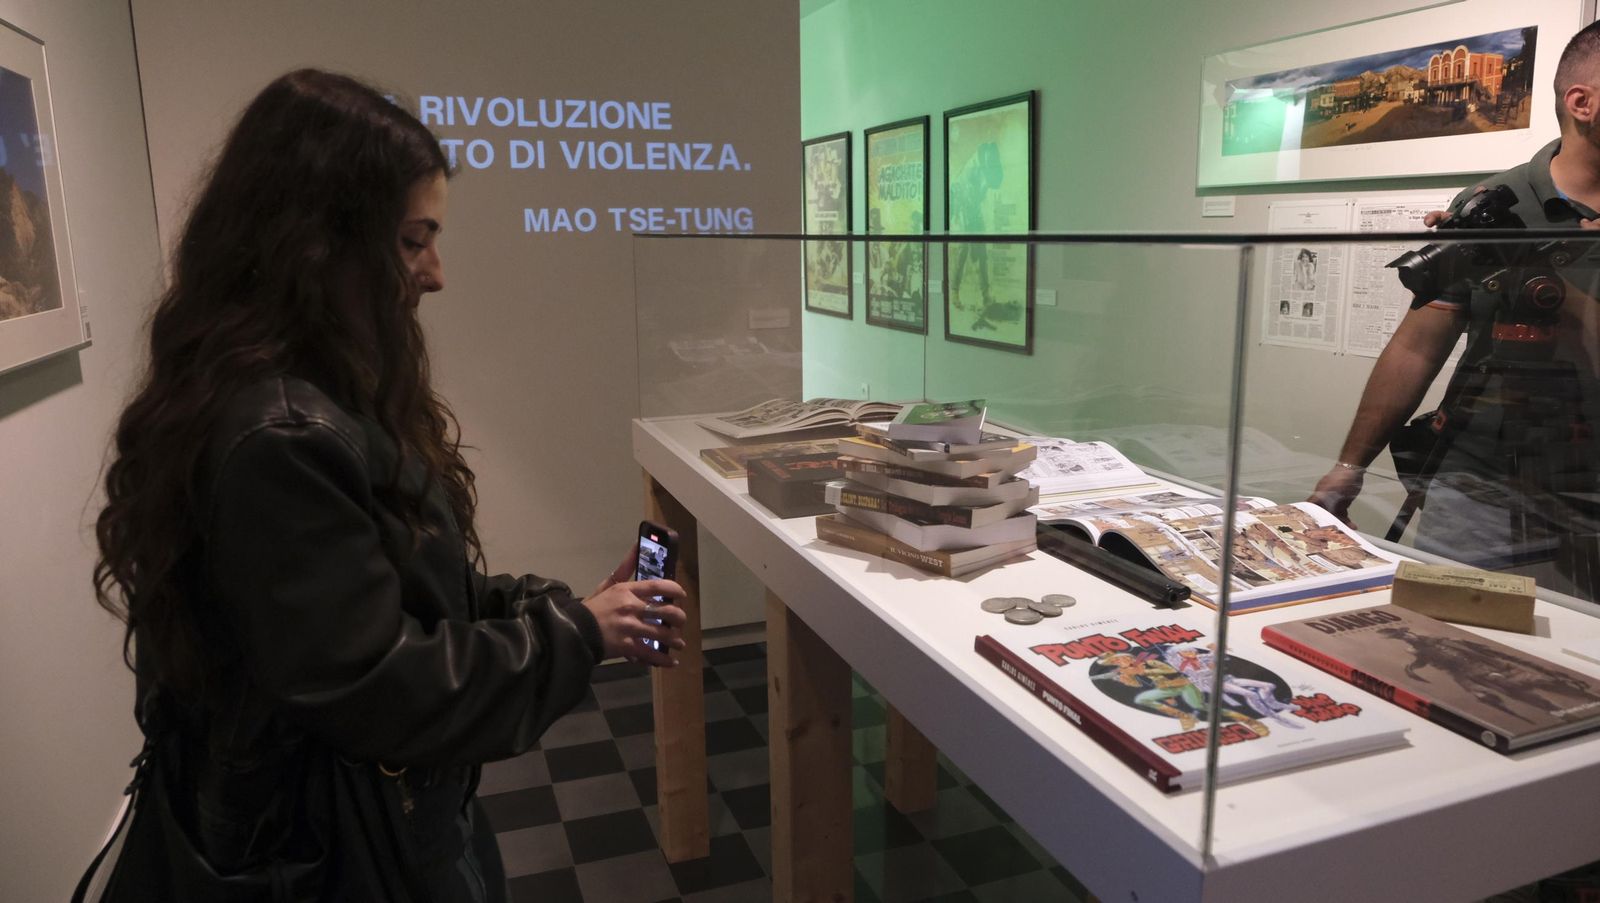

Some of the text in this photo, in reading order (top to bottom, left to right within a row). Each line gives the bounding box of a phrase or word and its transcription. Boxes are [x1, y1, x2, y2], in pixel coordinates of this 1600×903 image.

[420, 96, 673, 130] RIVOLUZIONE
[509, 140, 546, 169] DI
[559, 141, 752, 171] VIOLENZA.
[524, 207, 753, 232] MAO TSE-TUNG
[920, 554, 944, 567] WEST
[1304, 610, 1402, 635] DJANGO
[1028, 624, 1206, 667] PUNTO FINAL
[1042, 690, 1063, 711] PUNTO
[1063, 704, 1082, 725] FINAL
